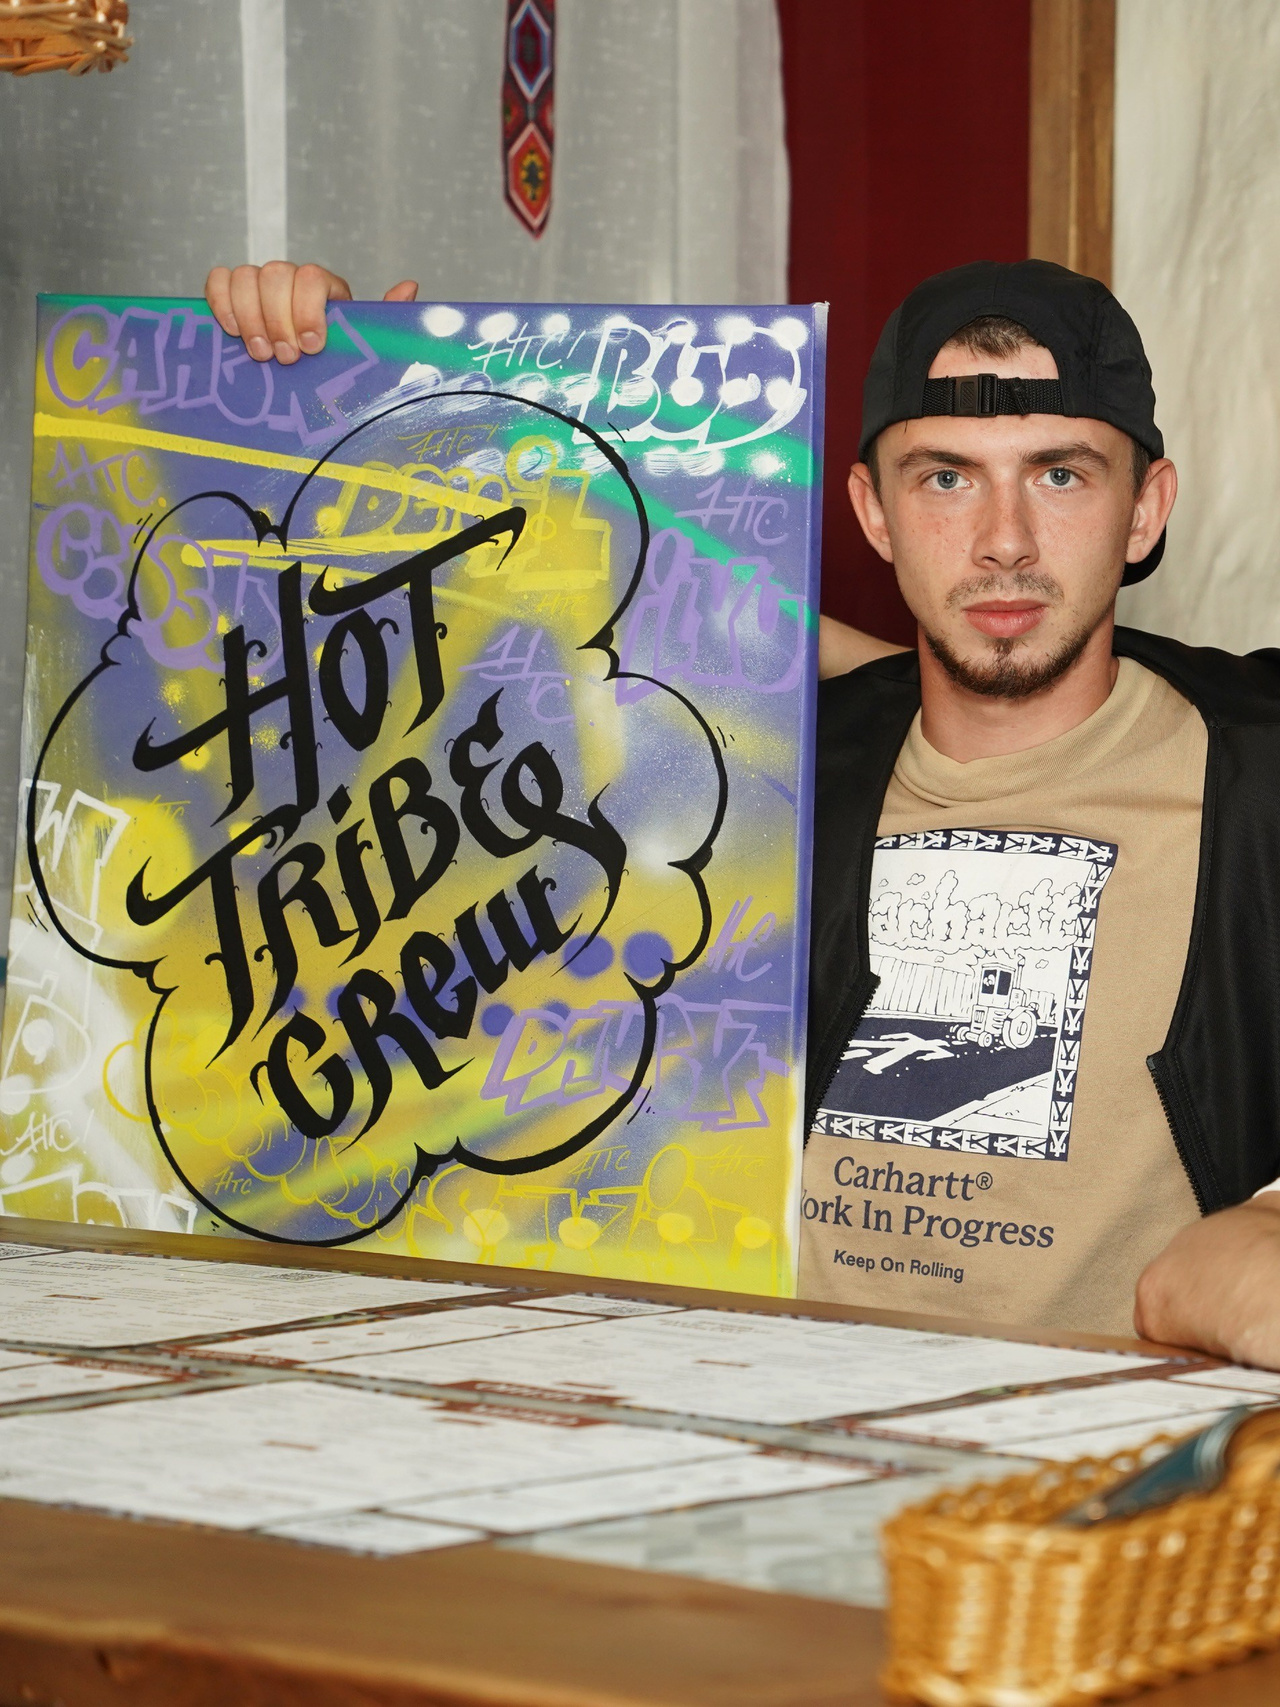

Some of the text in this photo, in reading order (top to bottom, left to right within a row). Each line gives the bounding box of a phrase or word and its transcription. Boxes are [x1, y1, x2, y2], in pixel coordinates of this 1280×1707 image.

[132, 506, 527, 828] HOT
[801, 1190, 1055, 1248] ork In Progress
[833, 1249, 965, 1284] Keep On Rolling
